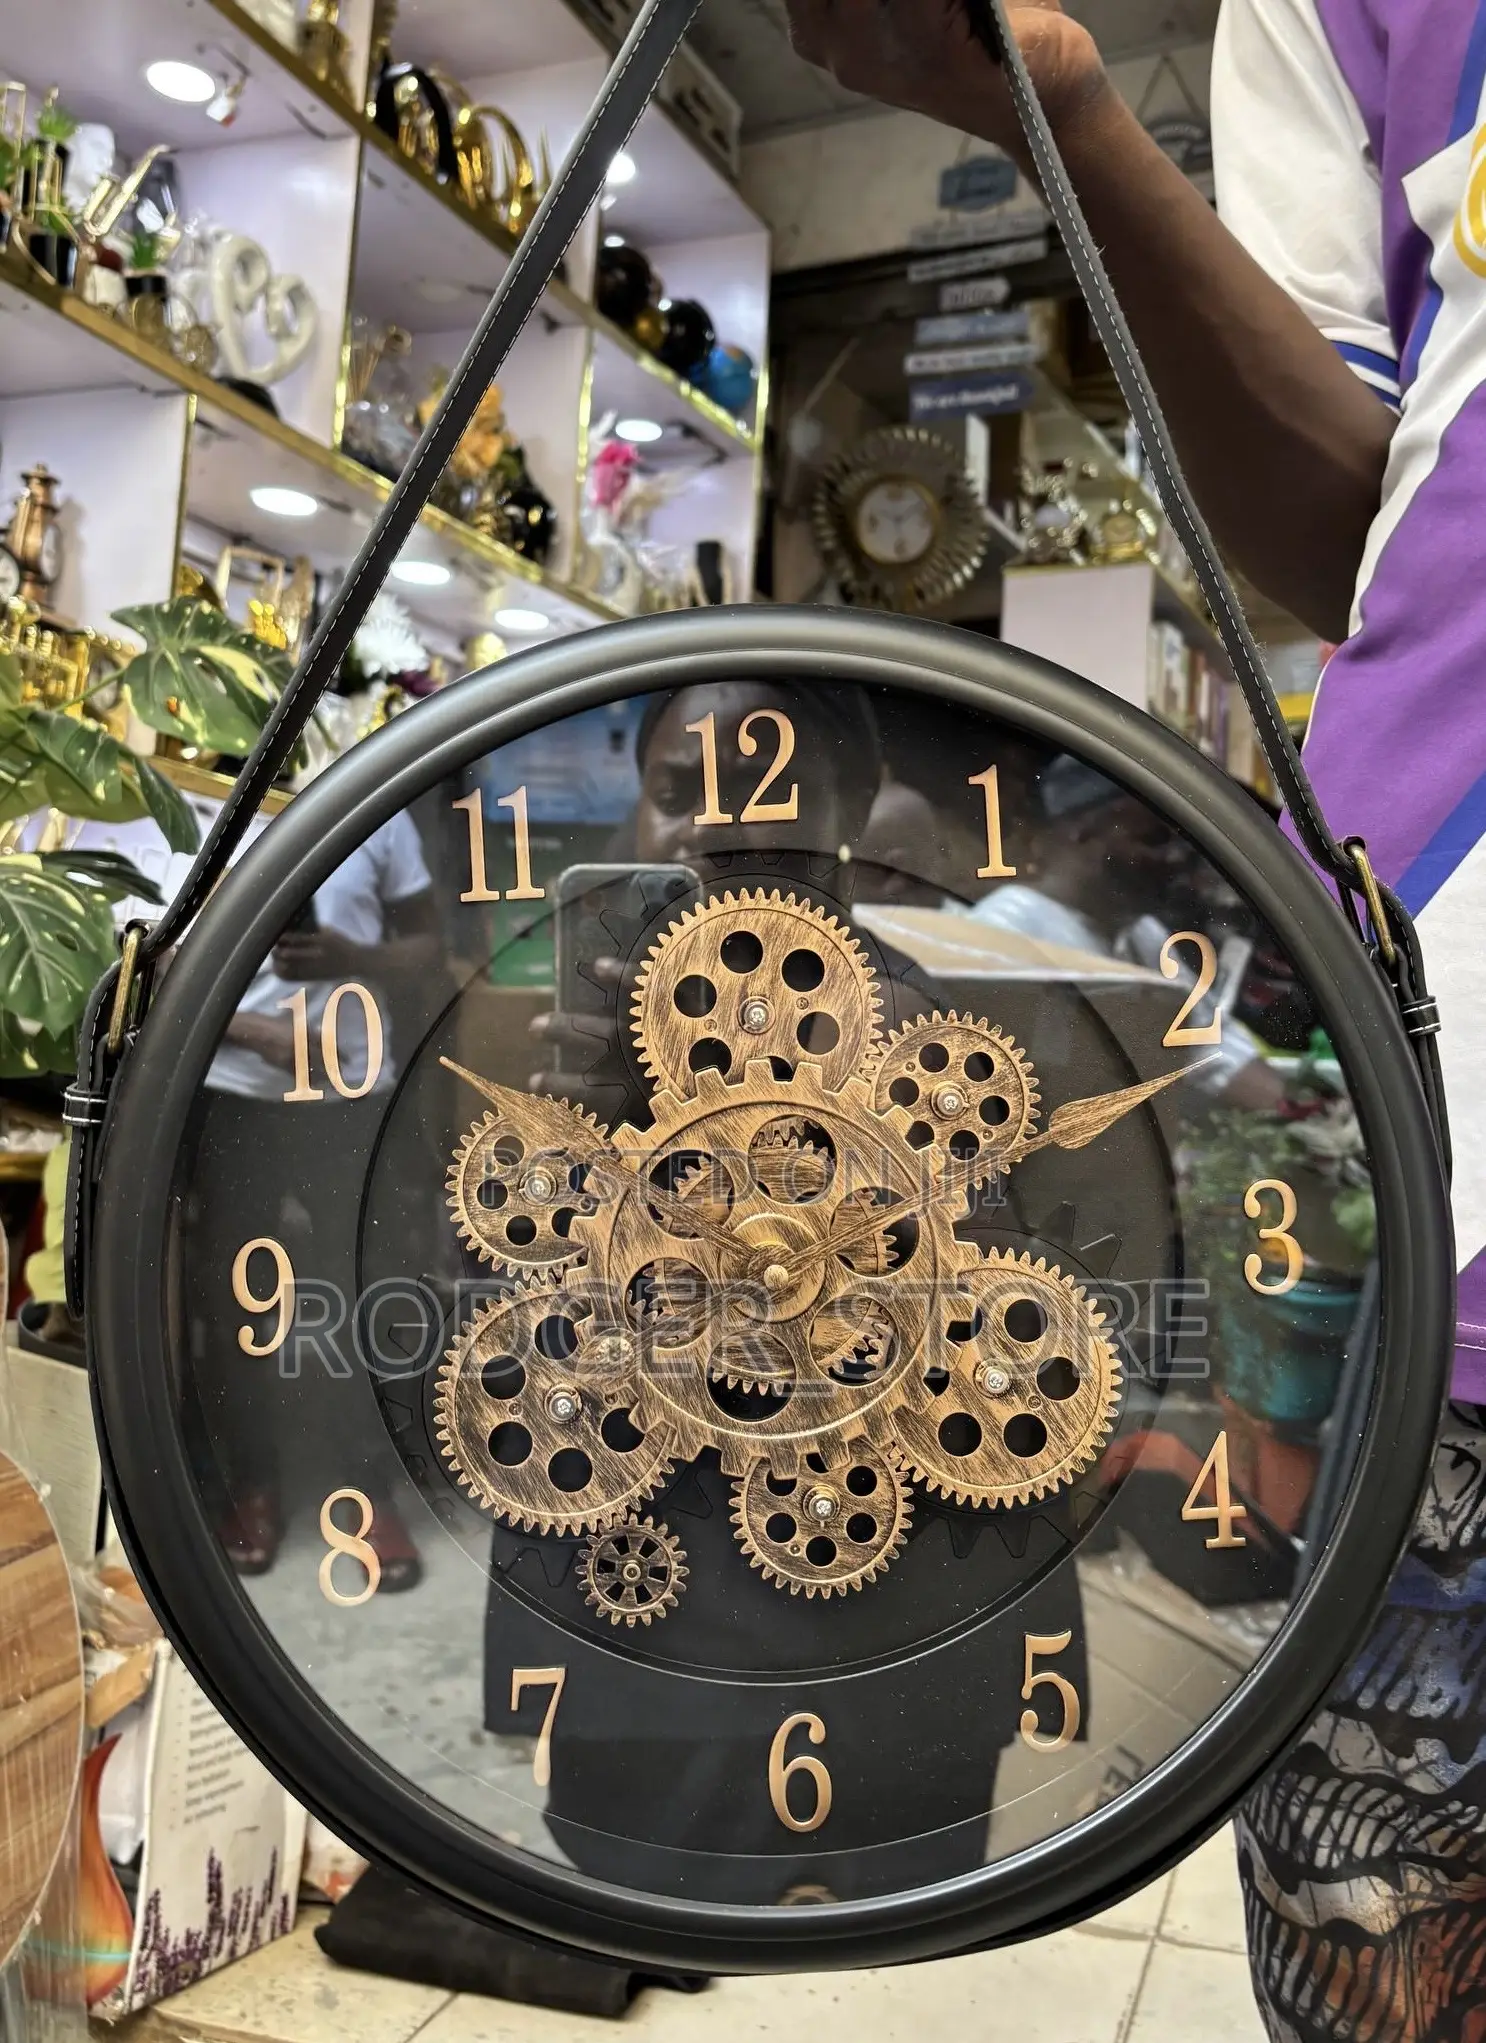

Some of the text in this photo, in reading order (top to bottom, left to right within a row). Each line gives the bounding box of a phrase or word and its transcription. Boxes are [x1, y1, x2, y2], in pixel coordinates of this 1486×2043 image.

[685, 708, 800, 827] 12
[967, 764, 1017, 878] 1
[452, 785, 546, 903] 11
[276, 982, 384, 1102] 10
[1160, 930, 1223, 1047] 2
[1243, 1178, 1304, 1296] 3
[232, 1237, 296, 1357] 9
[319, 1487, 381, 1607] 8
[1181, 1431, 1247, 1549] 4
[510, 1666, 568, 1787] 7
[1020, 1630, 1080, 1753] 5
[768, 1712, 832, 1833] 6
